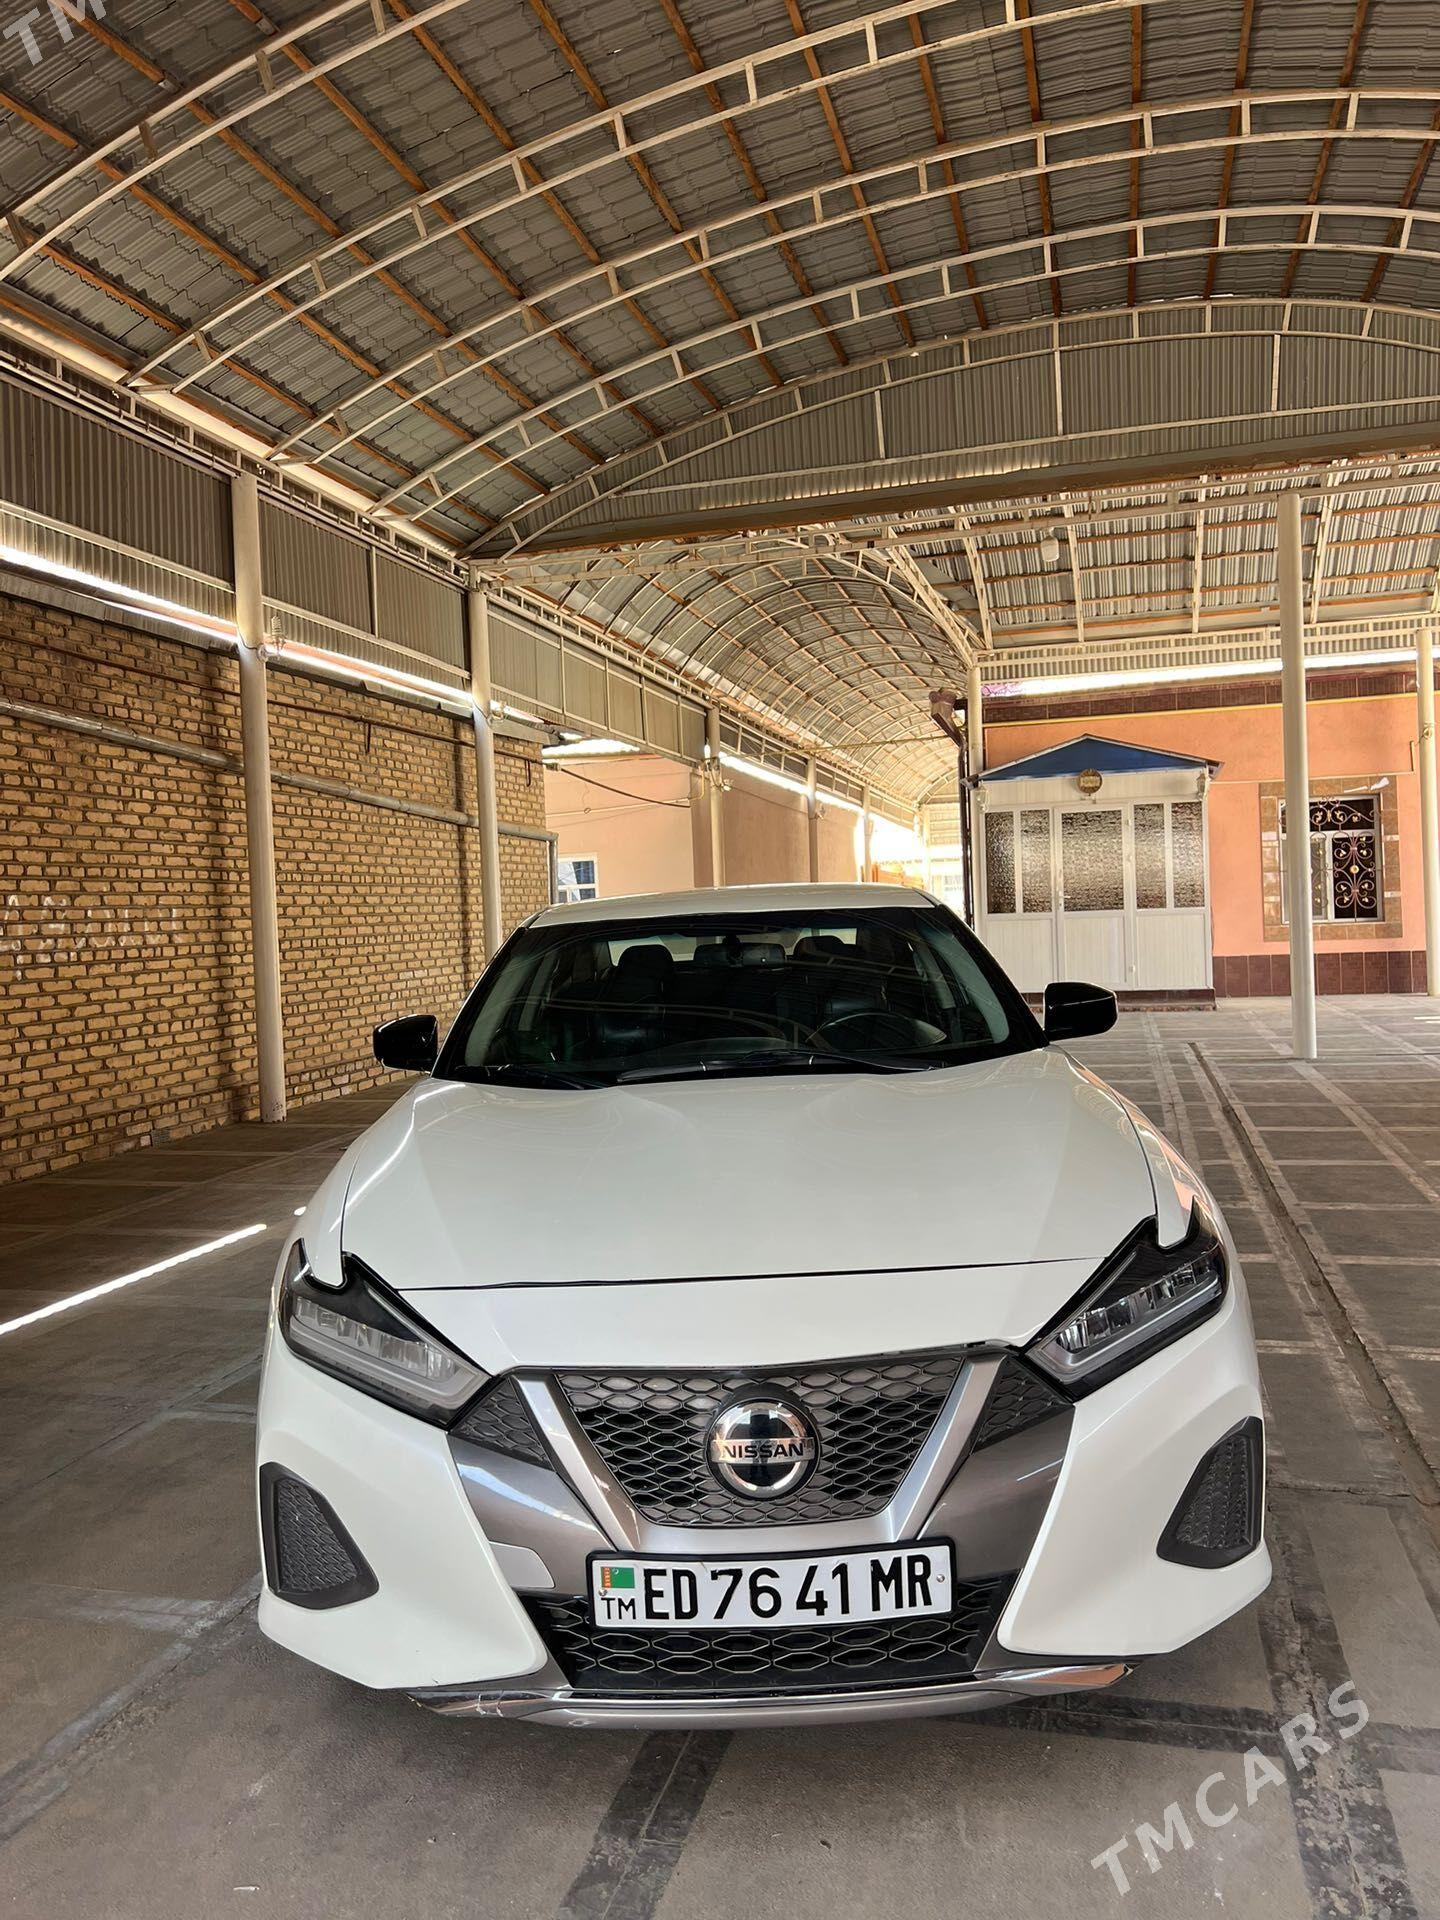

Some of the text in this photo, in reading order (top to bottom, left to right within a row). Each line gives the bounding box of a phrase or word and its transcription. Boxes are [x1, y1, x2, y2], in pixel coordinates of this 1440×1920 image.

[723, 1443, 804, 1459] NISSAN
[643, 1554, 933, 1620] ED 76 41 MR
[600, 1597, 637, 1620] TM
